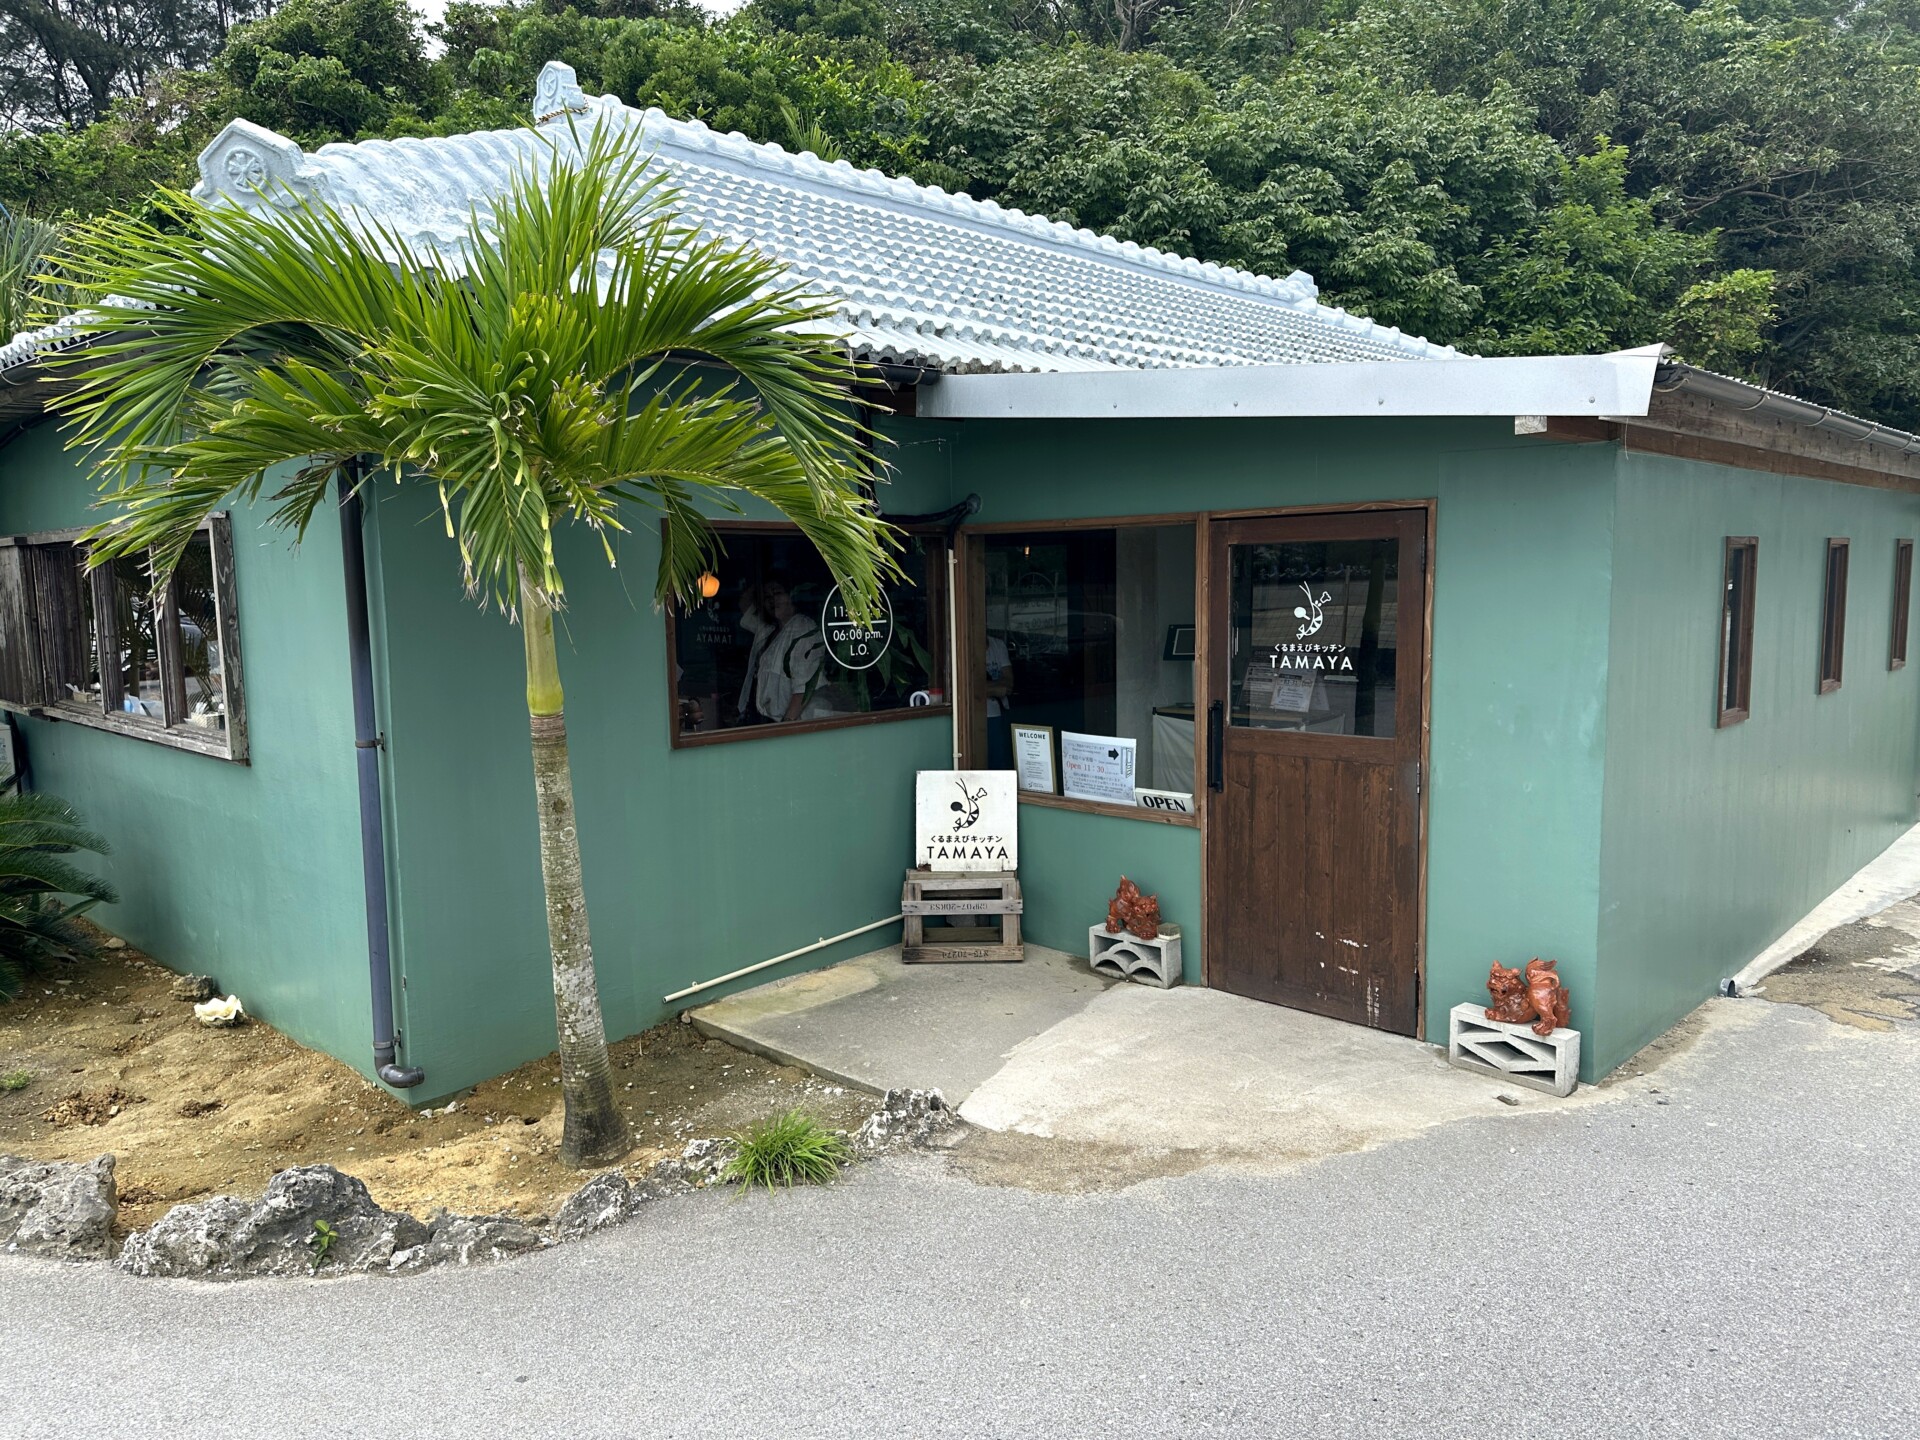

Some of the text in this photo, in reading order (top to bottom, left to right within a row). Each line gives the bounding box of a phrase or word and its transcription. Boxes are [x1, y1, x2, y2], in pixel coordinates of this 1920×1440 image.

[833, 628, 863, 642] 06:00
[849, 643, 870, 656] L.O.
[1275, 643, 1346, 652] くるまえびキッチン
[1269, 655, 1353, 670] TAMAYA
[1018, 732, 1046, 740] WELCOME
[1066, 760, 1082, 771] Open
[1142, 795, 1187, 812] OPEN
[930, 835, 1003, 843] くるまえびキッチン
[926, 846, 1008, 859] TAMAYA
